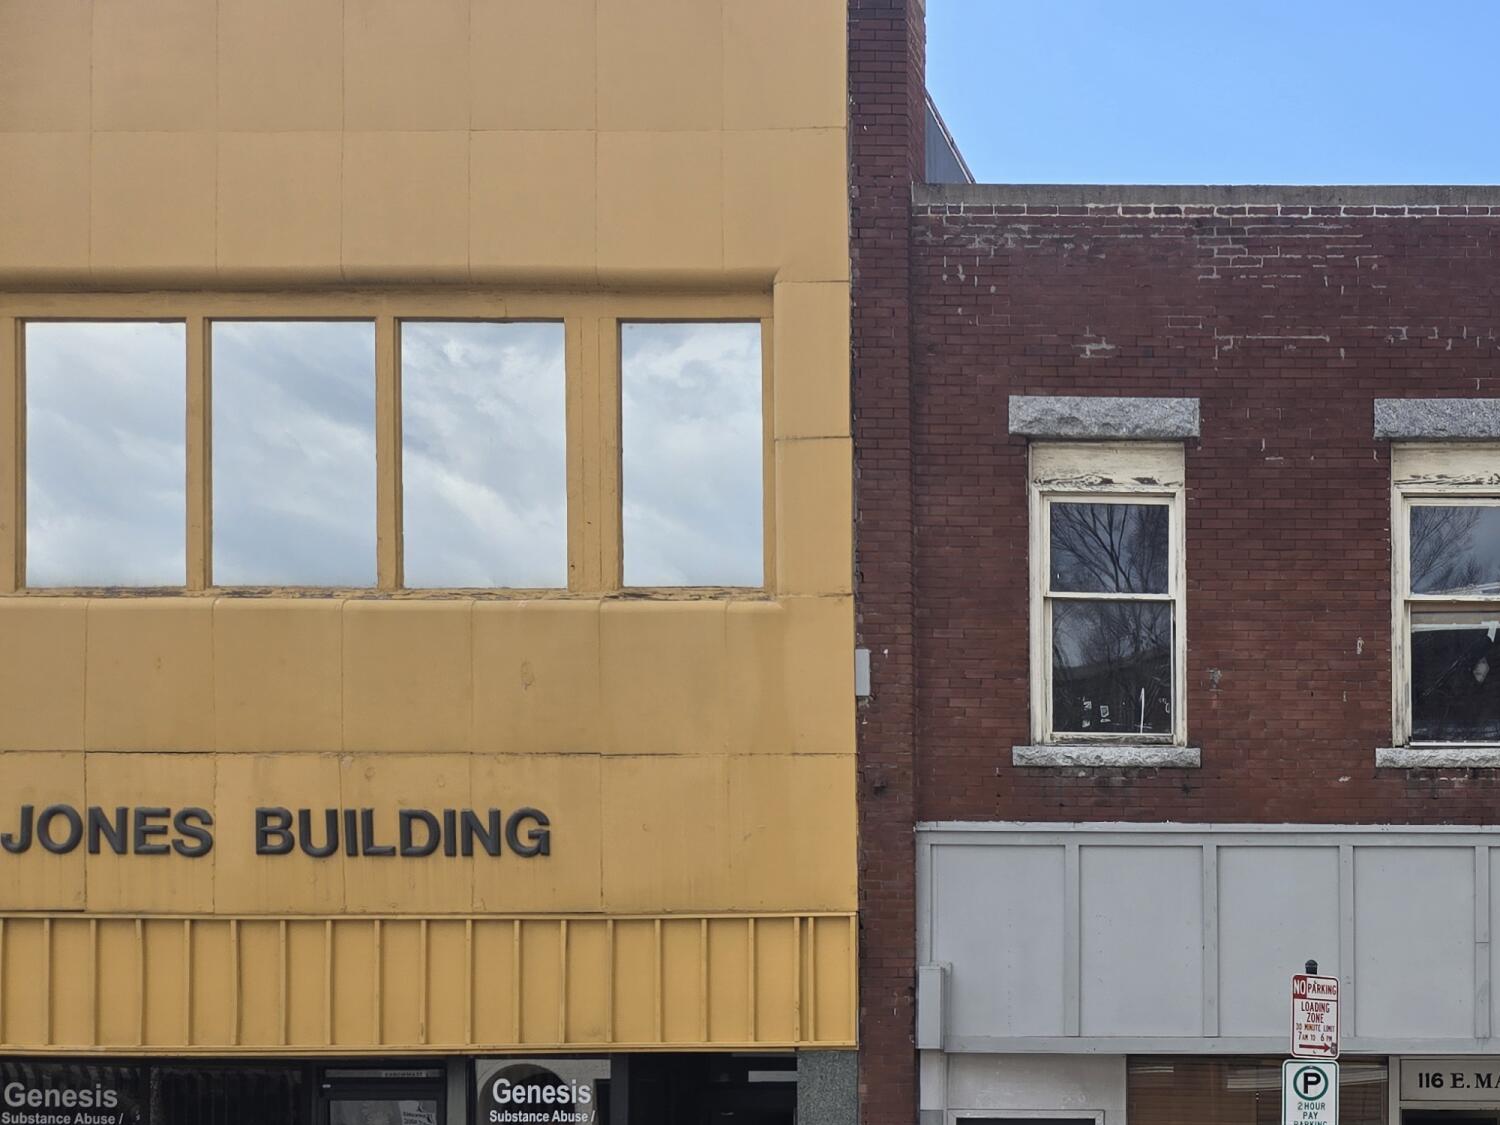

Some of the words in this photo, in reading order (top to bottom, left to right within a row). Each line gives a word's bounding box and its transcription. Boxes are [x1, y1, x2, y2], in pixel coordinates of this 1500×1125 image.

[2, 804, 214, 858] JONES
[255, 806, 551, 858] BUILDING
[1293, 979, 1306, 995] NO
[1307, 983, 1337, 996] PARKING
[1301, 1001, 1330, 1013] LOADING
[1306, 1012, 1325, 1024] ZONE
[1304, 1023, 1321, 1032] MINUTE
[1303, 1072, 1322, 1094] P
[1418, 1072, 1445, 1089] 116
[1449, 1072, 1471, 1089] E.
[4, 1082, 118, 1108] Genesis
[492, 1078, 593, 1104] Genesis
[1, 1111, 71, 1124] Substance
[74, 1112, 116, 1125] Abuse
[118, 1112, 124, 1125] /
[489, 1109, 550, 1123] Substance
[552, 1110, 589, 1123] Abuse
[590, 1110, 596, 1123] /
[1302, 1111, 1319, 1120] PAY
